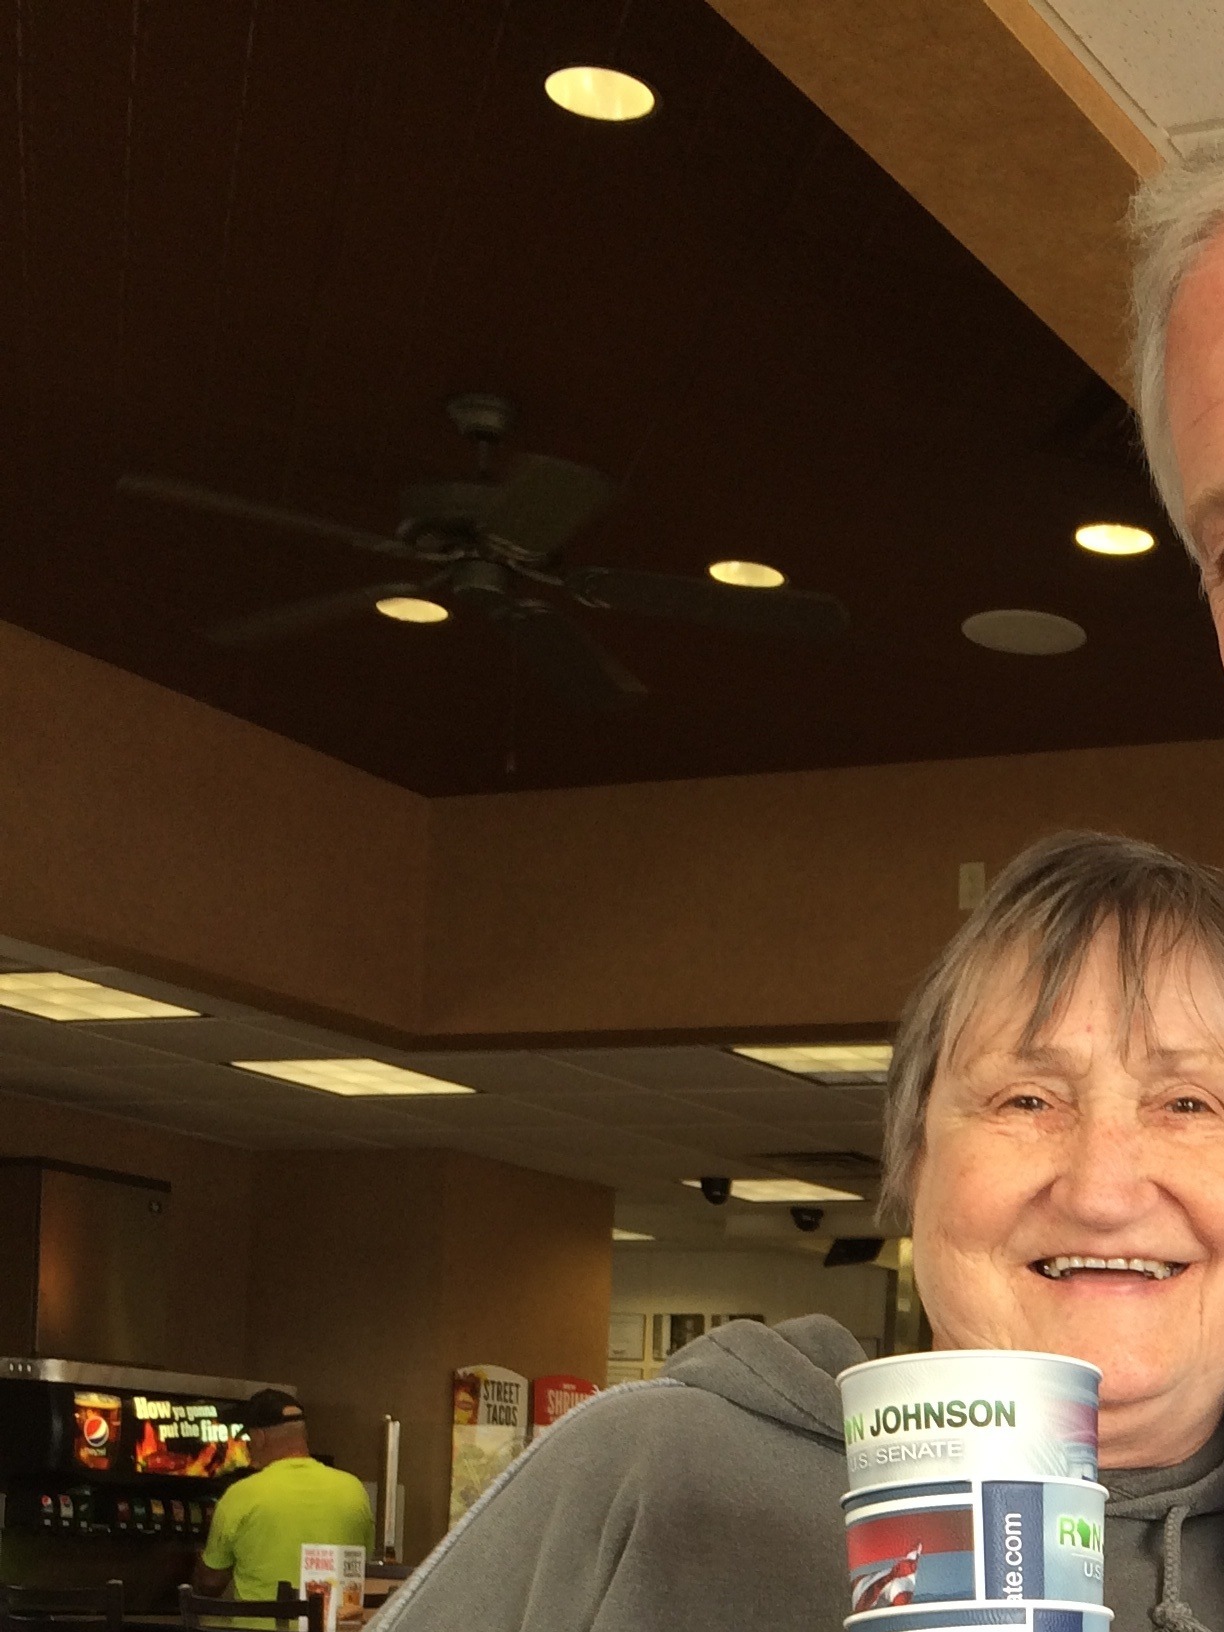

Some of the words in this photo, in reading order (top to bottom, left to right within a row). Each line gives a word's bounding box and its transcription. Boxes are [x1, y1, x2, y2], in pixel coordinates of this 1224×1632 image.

[483, 1381, 521, 1404] STREET
[133, 1397, 171, 1420] How
[486, 1403, 518, 1427] TACOS
[870, 1399, 1016, 1438] JOHNSON
[158, 1422, 179, 1442] put
[180, 1421, 200, 1438] the
[201, 1420, 228, 1442] fire
[875, 1440, 964, 1466] SENATE
